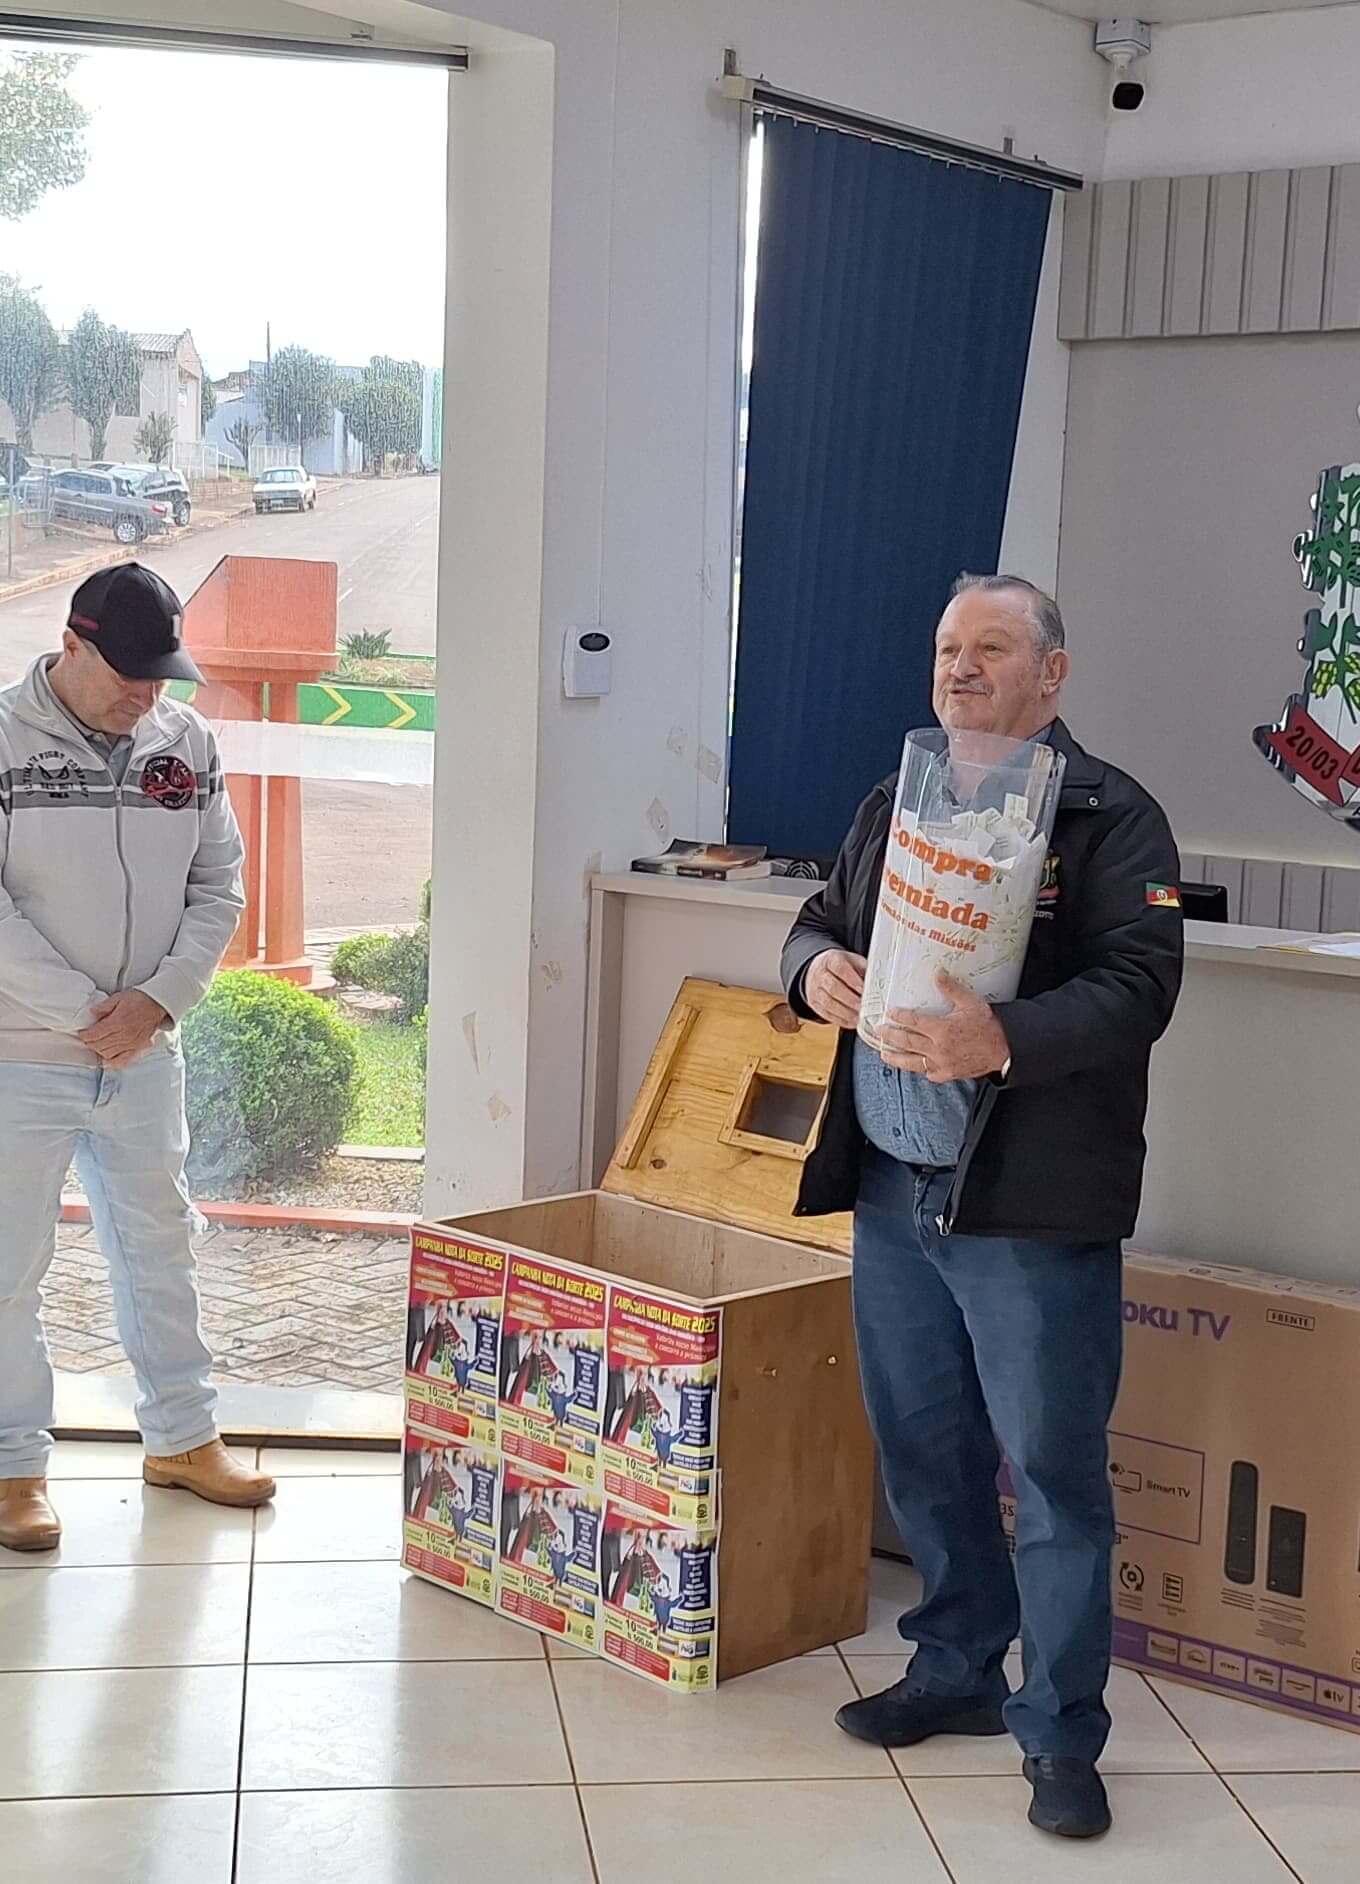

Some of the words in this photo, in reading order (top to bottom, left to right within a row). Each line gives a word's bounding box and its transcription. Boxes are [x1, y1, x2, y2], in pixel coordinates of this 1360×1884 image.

[1286, 725, 1340, 780] 20/03
[484, 1252, 504, 1270] 2025
[584, 1281, 605, 1303] 2025
[690, 1315, 717, 1334] 2025
[1121, 1300, 1179, 1331] oku
[1186, 1308, 1231, 1341] TV
[1271, 1311, 1309, 1328] FRENTE
[427, 1384, 438, 1398] 10
[522, 1416, 533, 1431] 10
[625, 1456, 637, 1470] 10
[1146, 1480, 1176, 1495] Smart
[1176, 1485, 1191, 1499] TV
[522, 1573, 534, 1587] 10
